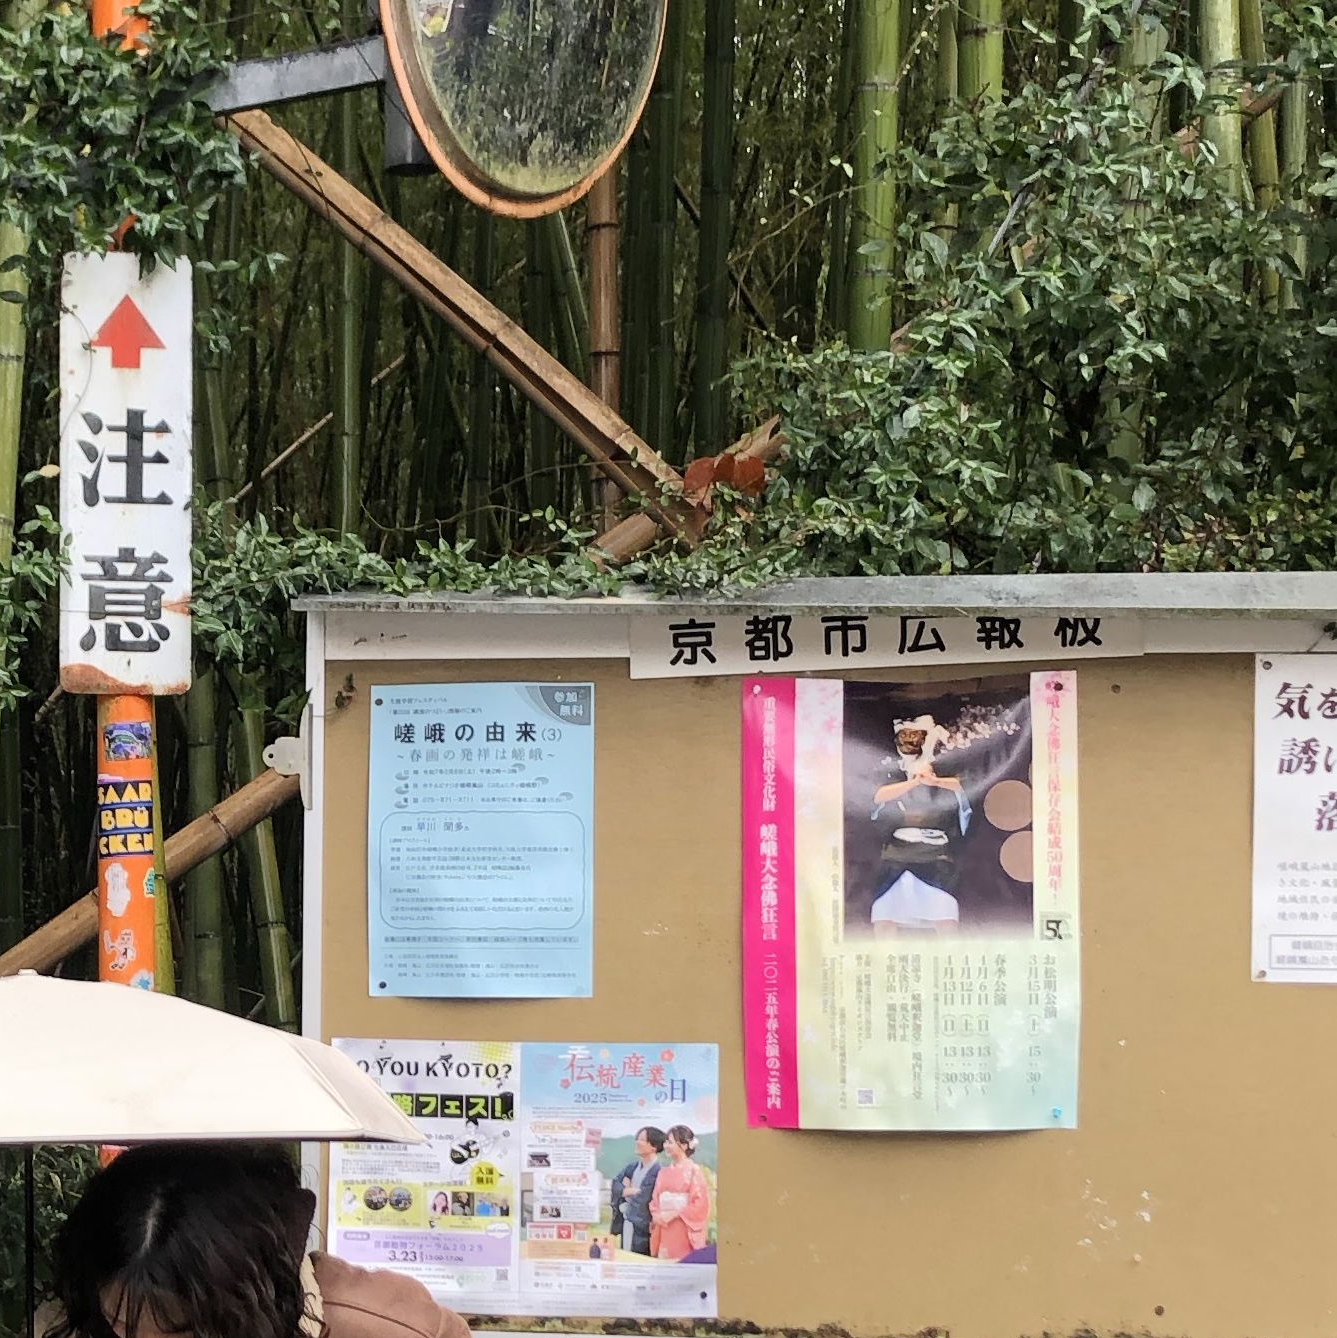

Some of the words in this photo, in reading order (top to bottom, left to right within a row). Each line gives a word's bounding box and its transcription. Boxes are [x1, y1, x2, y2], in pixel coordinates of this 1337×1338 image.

[76, 408, 174, 653] 注意
[666, 614, 1104, 668] 京都市広報板
[559, 704, 584, 717] 無料
[394, 721, 562, 743] 嵯峨の由来(3)
[759, 822, 779, 941] 嵯峨大念佛狂言
[763, 952, 782, 1110] 二〇二五年春公演のご案内
[426, 1056, 512, 1080] KYOTO?
[574, 1092, 608, 1104] 2025
[387, 1250, 418, 1263] 3.23
